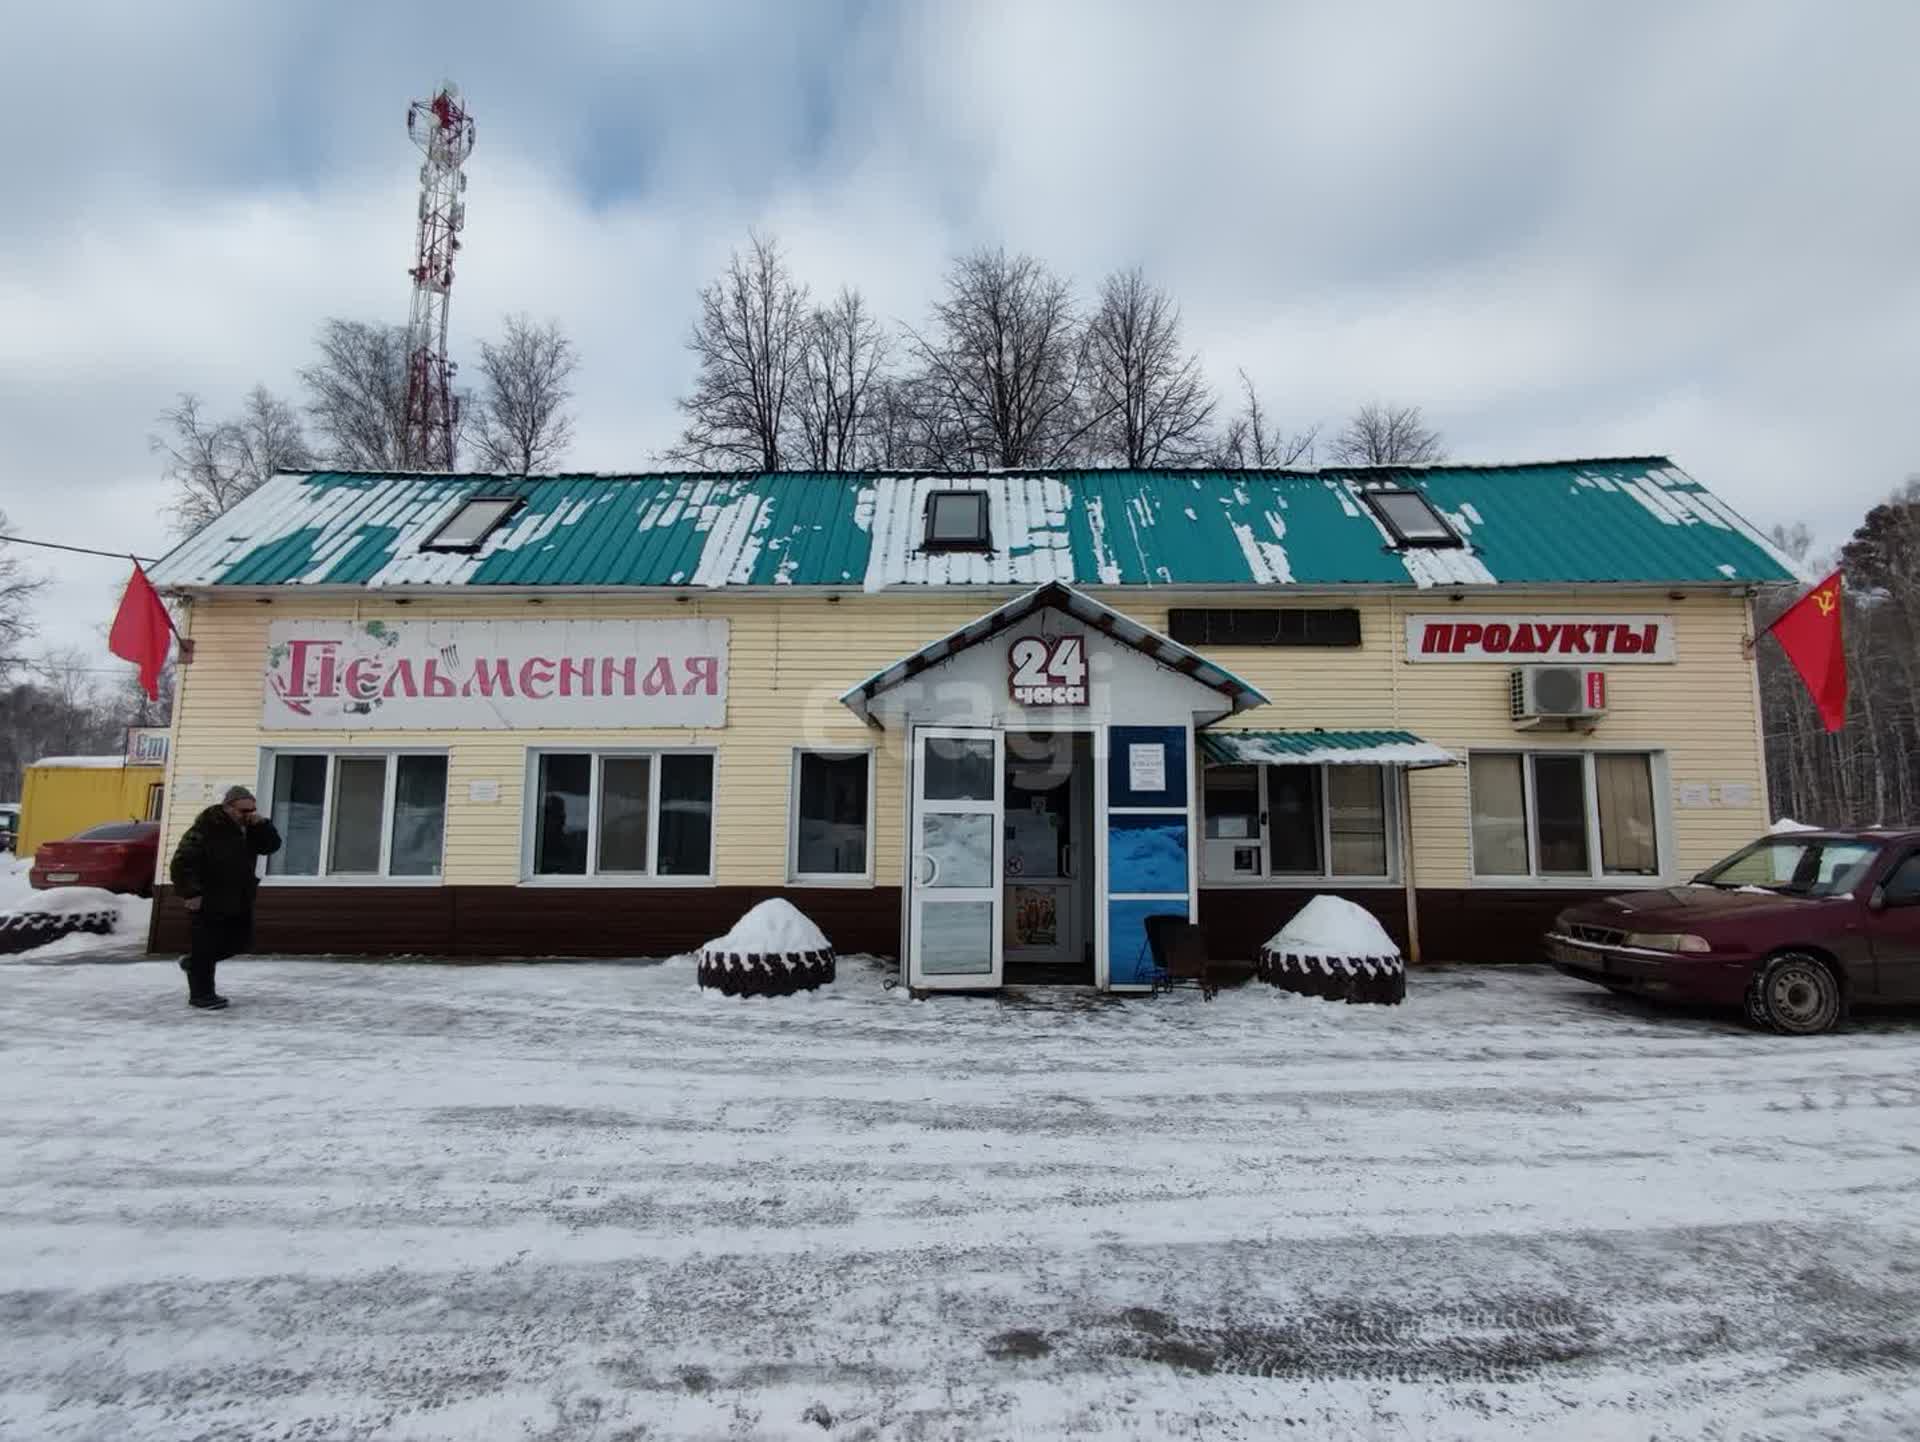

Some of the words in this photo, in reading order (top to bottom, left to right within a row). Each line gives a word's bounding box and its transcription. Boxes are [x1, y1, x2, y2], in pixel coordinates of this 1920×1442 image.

[1421, 624, 1659, 654] ПРОДУКТЫ
[1011, 638, 1086, 686] 24
[1014, 687, 1086, 704] часа
